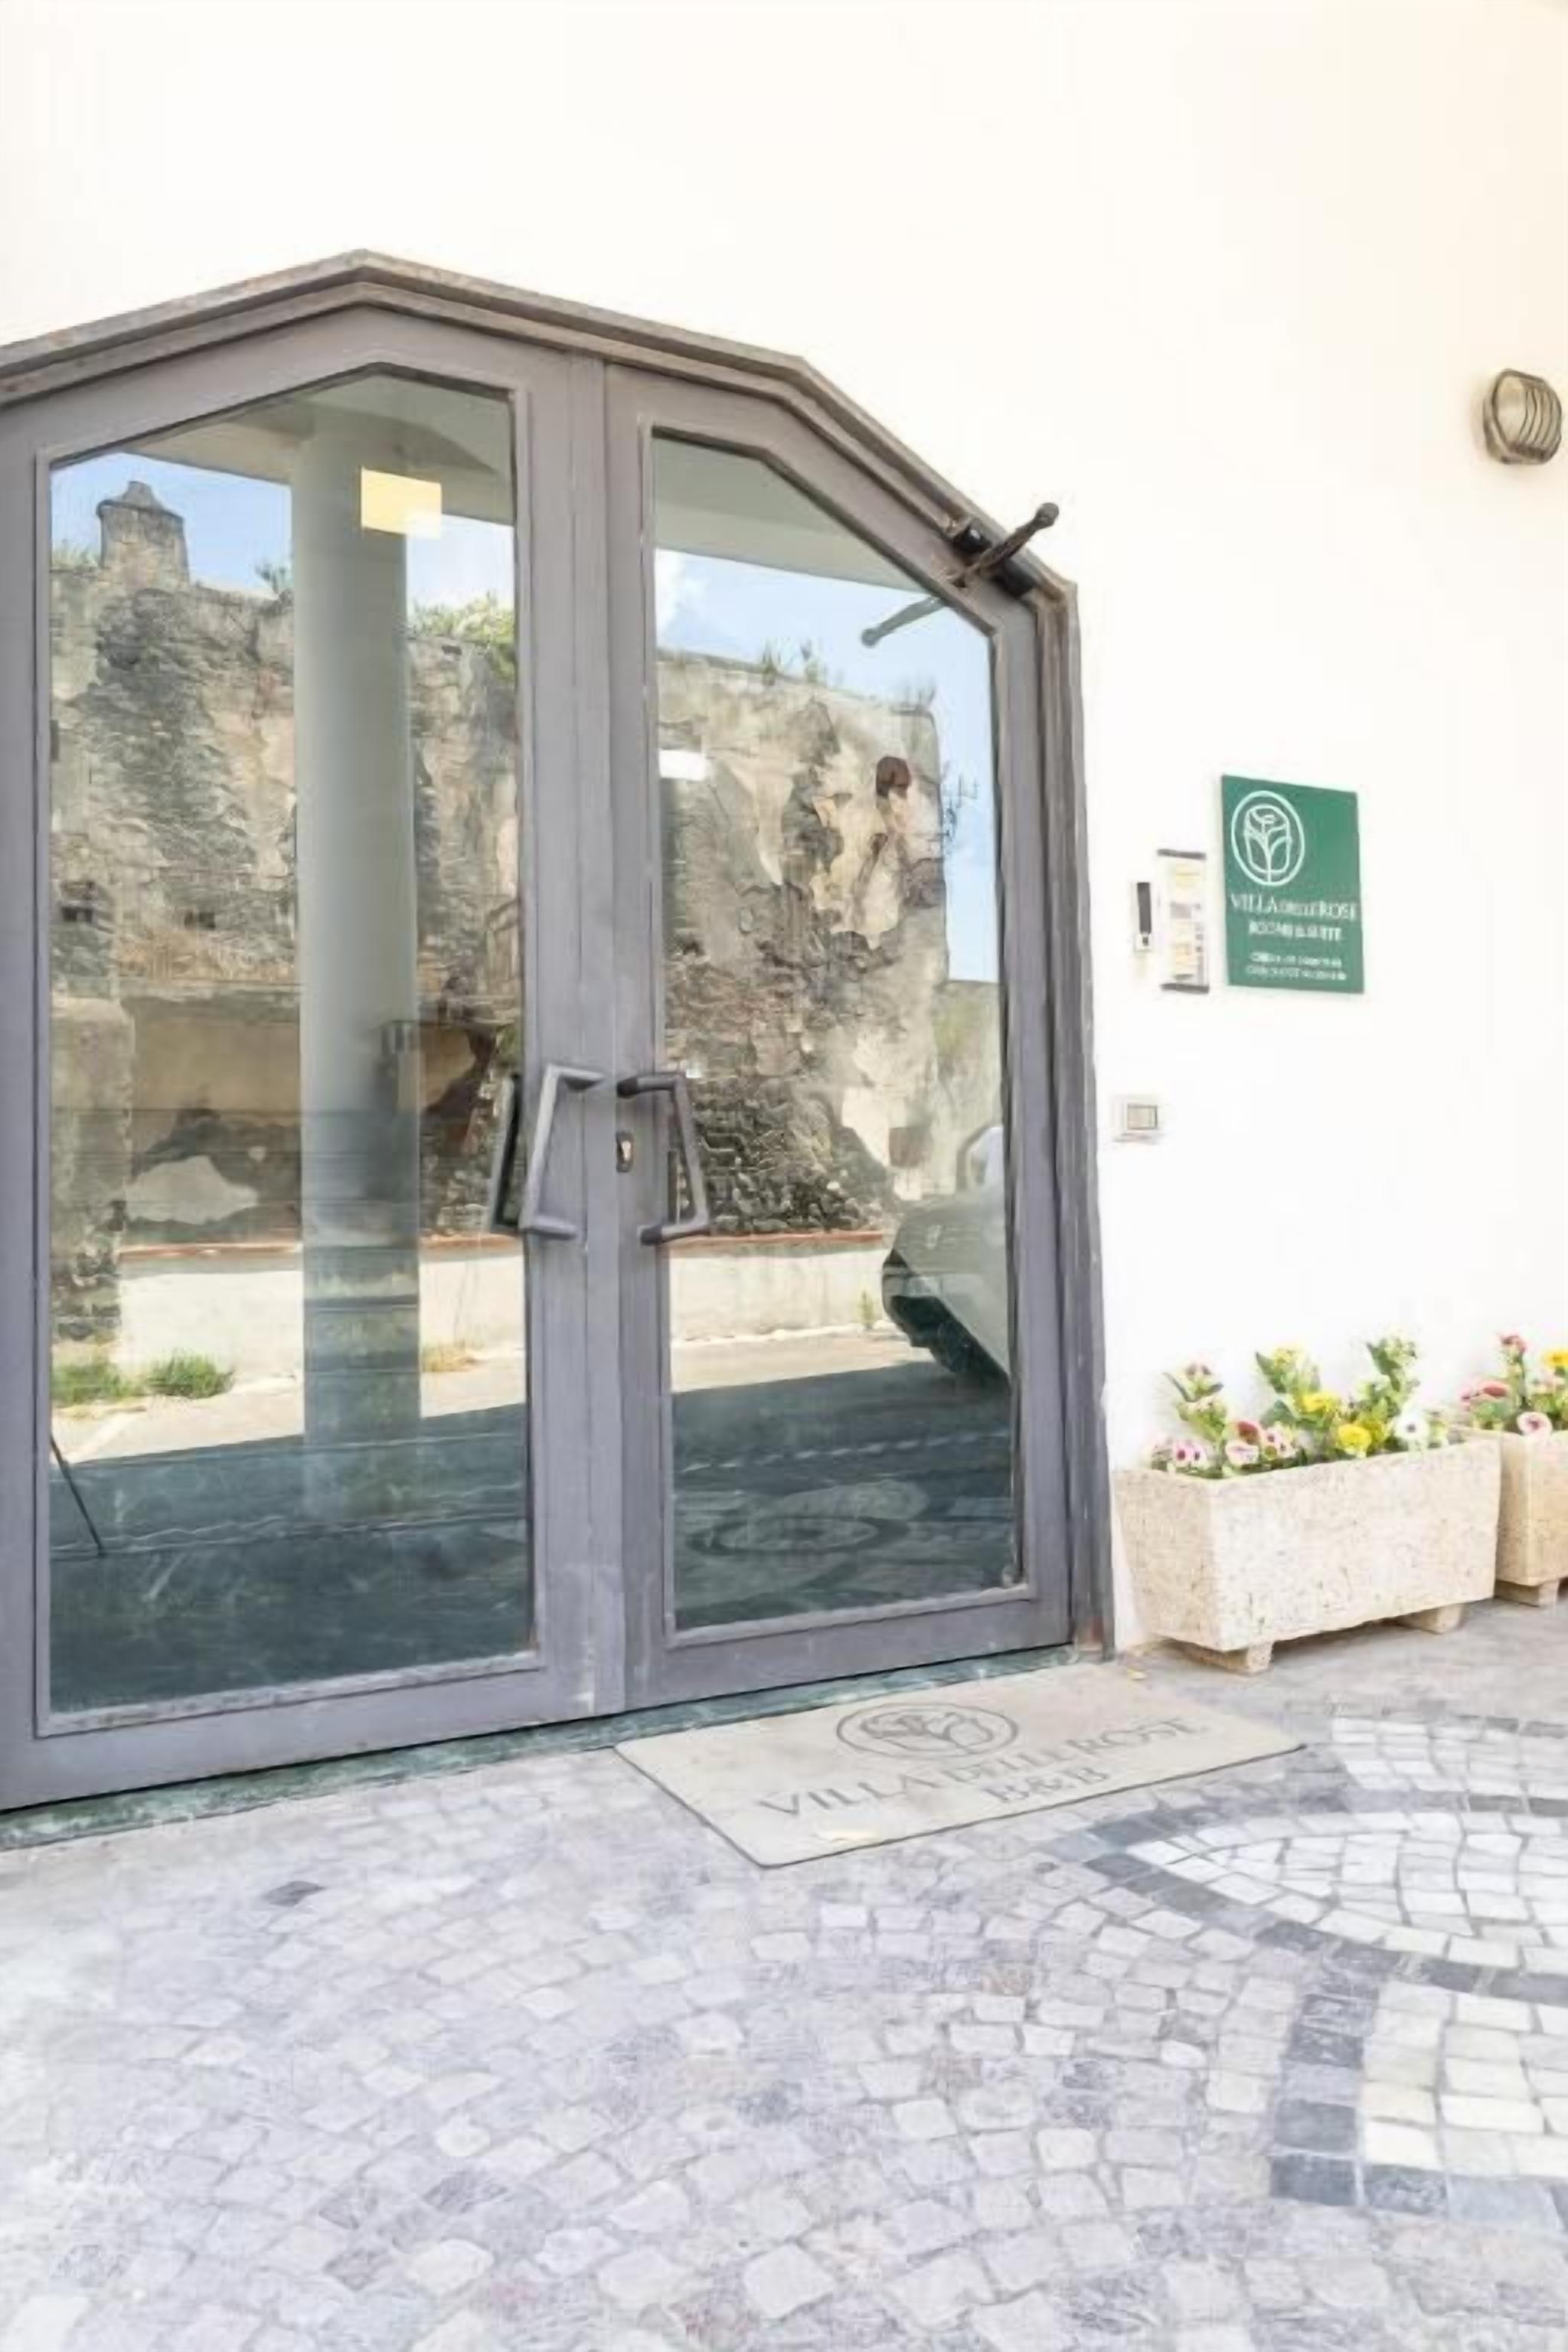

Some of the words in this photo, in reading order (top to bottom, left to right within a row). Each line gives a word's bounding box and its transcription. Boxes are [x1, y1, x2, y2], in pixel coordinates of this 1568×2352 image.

[1230, 893, 1278, 913] VILLA
[757, 1771, 945, 1816] VILLA
[1065, 1717, 1206, 1756] ROSE
